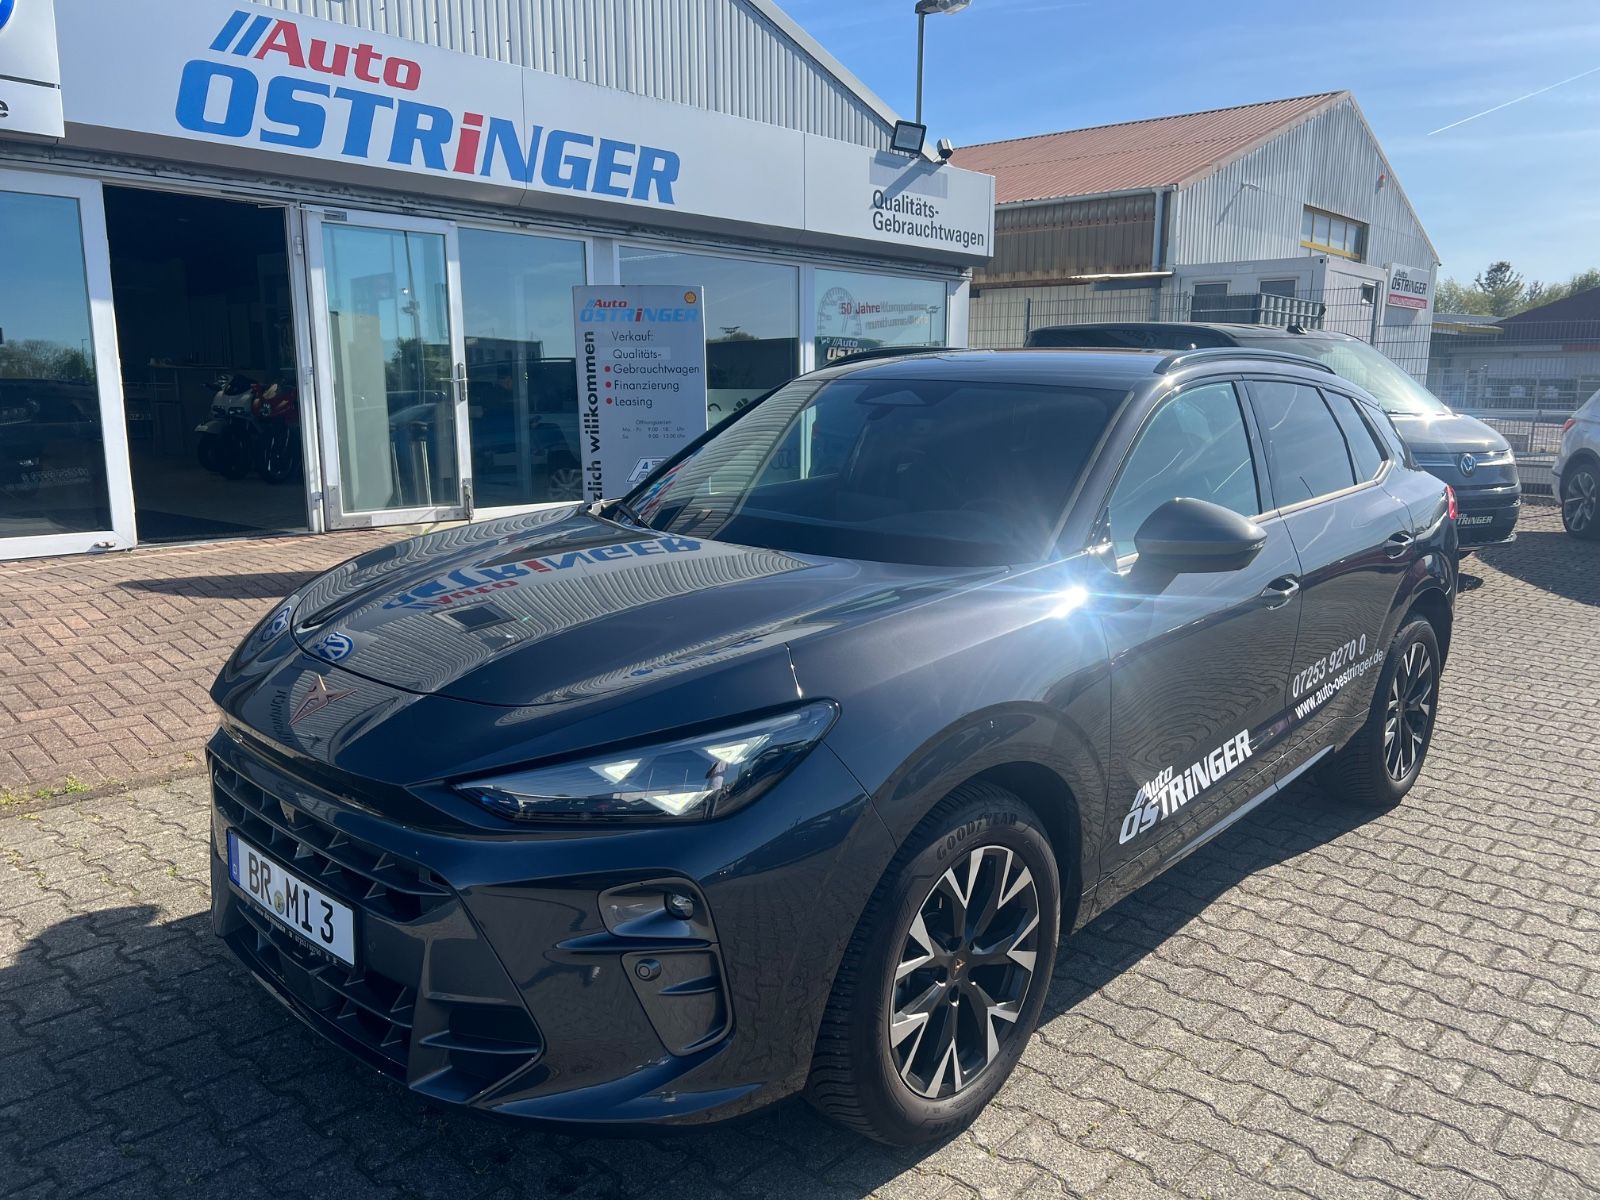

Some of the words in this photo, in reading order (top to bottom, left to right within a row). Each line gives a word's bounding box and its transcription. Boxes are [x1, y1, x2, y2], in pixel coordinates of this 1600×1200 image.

[872, 189, 939, 219] Qualitäts-
[872, 211, 984, 248] Gebrauchtwagen
[840, 303, 852, 315] 50
[855, 302, 880, 315] Jahre
[611, 330, 654, 342] Verkauf:
[612, 348, 662, 360] Qualitäts-
[613, 363, 700, 377] Gebrauchtwagen
[584, 331, 601, 453] willkommen
[614, 380, 680, 392] Finanzierung
[614, 396, 653, 409] Leasing
[586, 460, 602, 501] zlich
[1292, 657, 1327, 698] 07253
[1328, 639, 1357, 673] 9270
[1359, 633, 1367, 655] 0
[1294, 648, 1384, 719] www.auto-oestringer.de
[248, 851, 273, 906] BR
[285, 877, 313, 934] MI
[320, 899, 334, 944] 3
